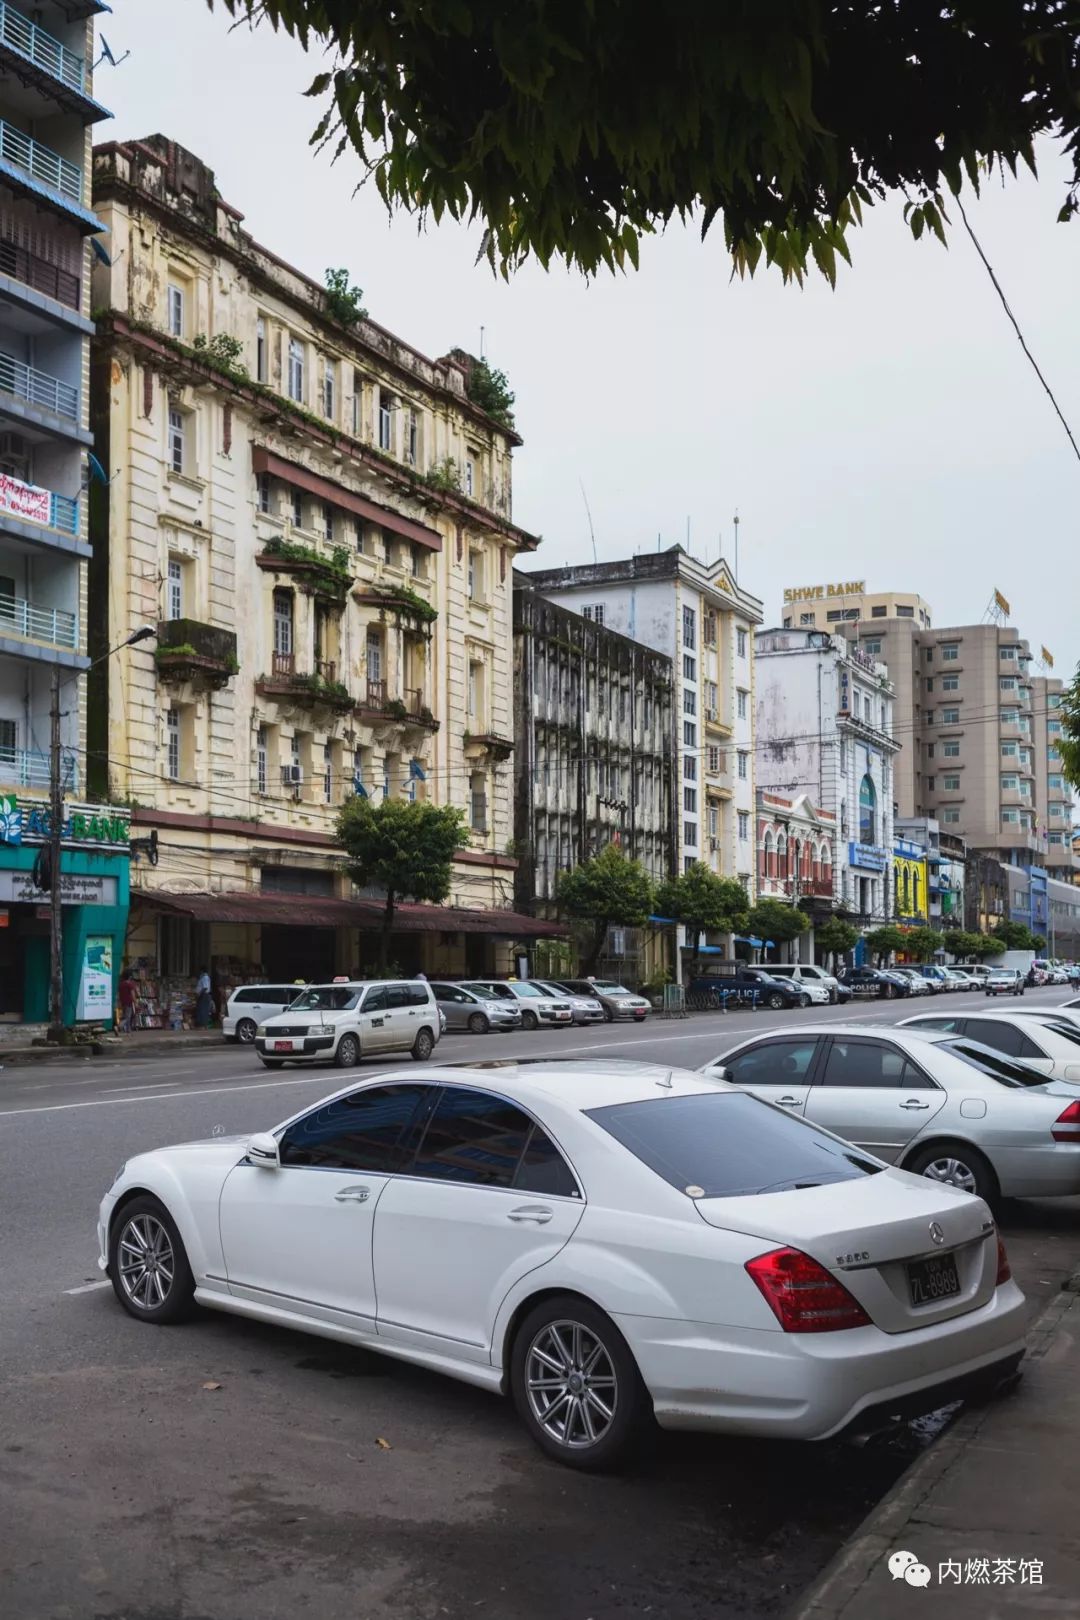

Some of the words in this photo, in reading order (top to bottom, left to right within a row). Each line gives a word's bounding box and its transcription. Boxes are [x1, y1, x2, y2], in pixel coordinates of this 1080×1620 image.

[784, 585, 824, 602] SHWE
[827, 581, 865, 597] BANK
[73, 814, 130, 842] BANK
[850, 984, 881, 992] POLICE
